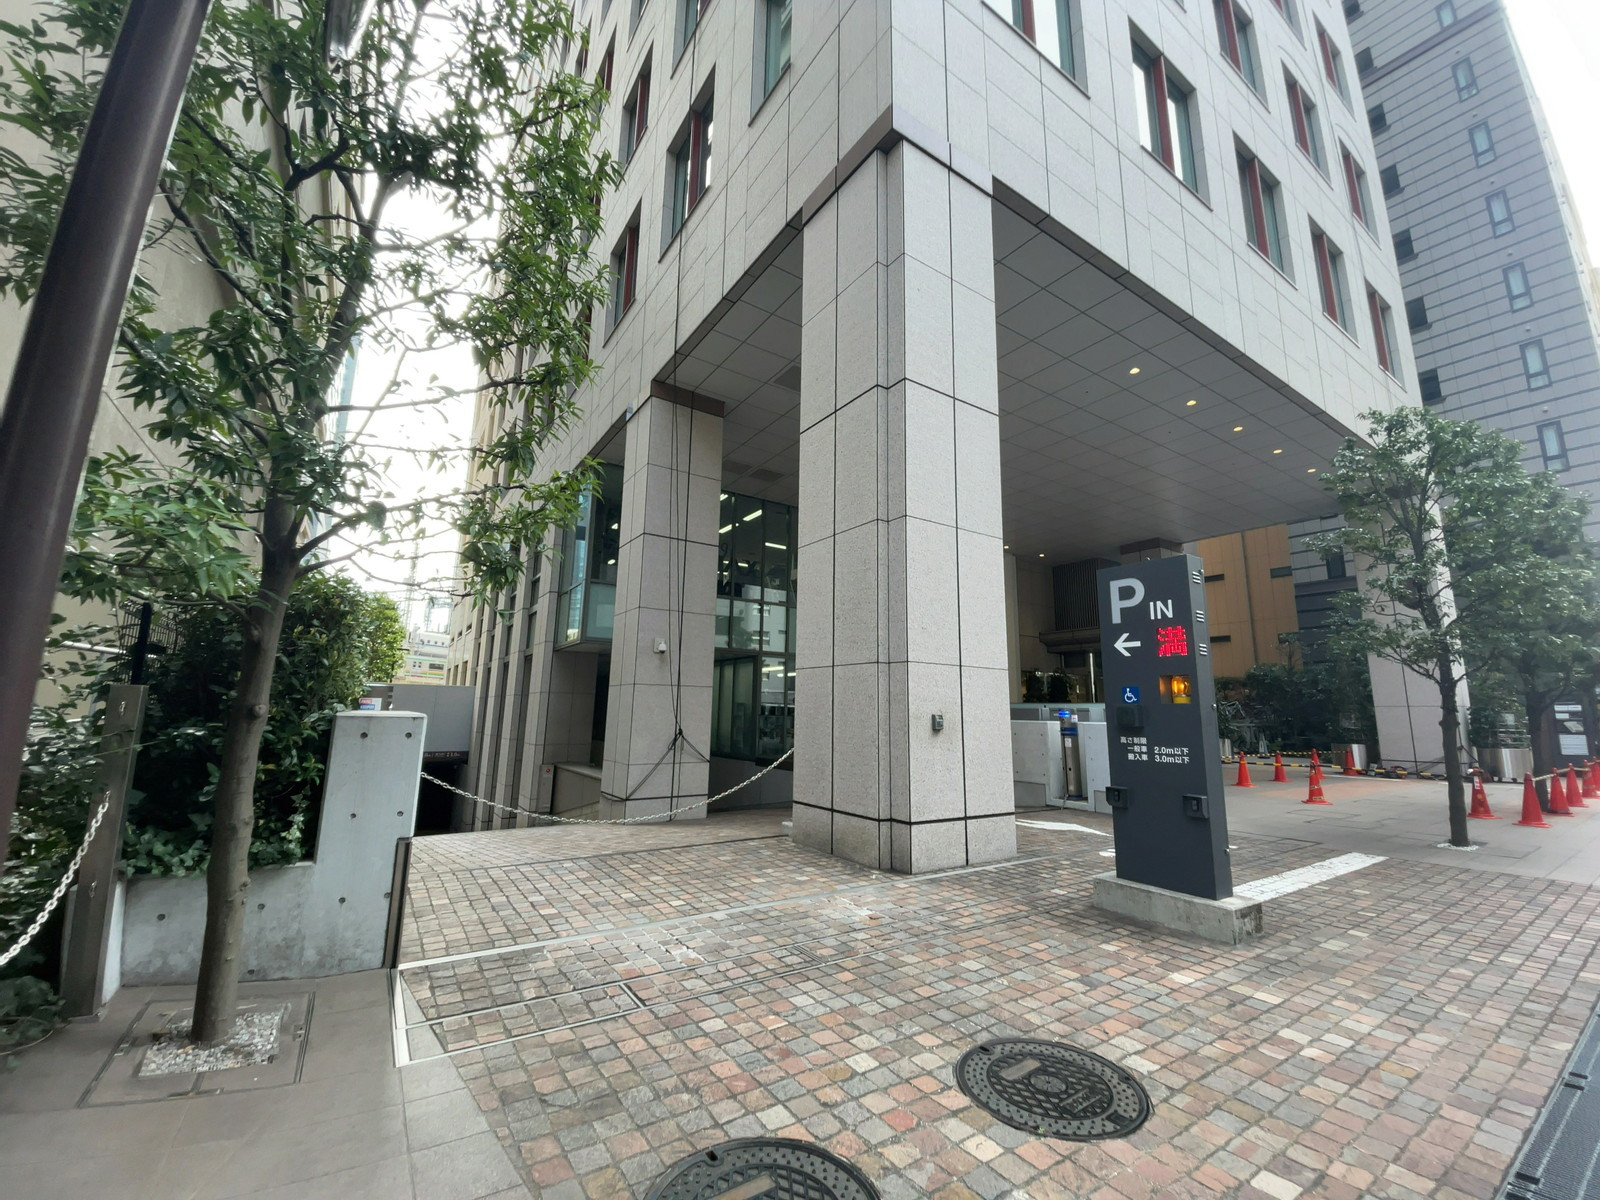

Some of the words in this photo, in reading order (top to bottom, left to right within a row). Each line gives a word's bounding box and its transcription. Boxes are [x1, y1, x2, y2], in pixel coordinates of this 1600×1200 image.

[1109, 577, 1145, 624] P
[1149, 599, 1174, 620] IN
[1157, 625, 1189, 657] 満
[1120, 736, 1147, 744] 高さ制限
[1127, 745, 1148, 753] 一般車
[1154, 746, 1189, 755] 2.0m以下
[1154, 754, 1190, 764] 3.0m以下
